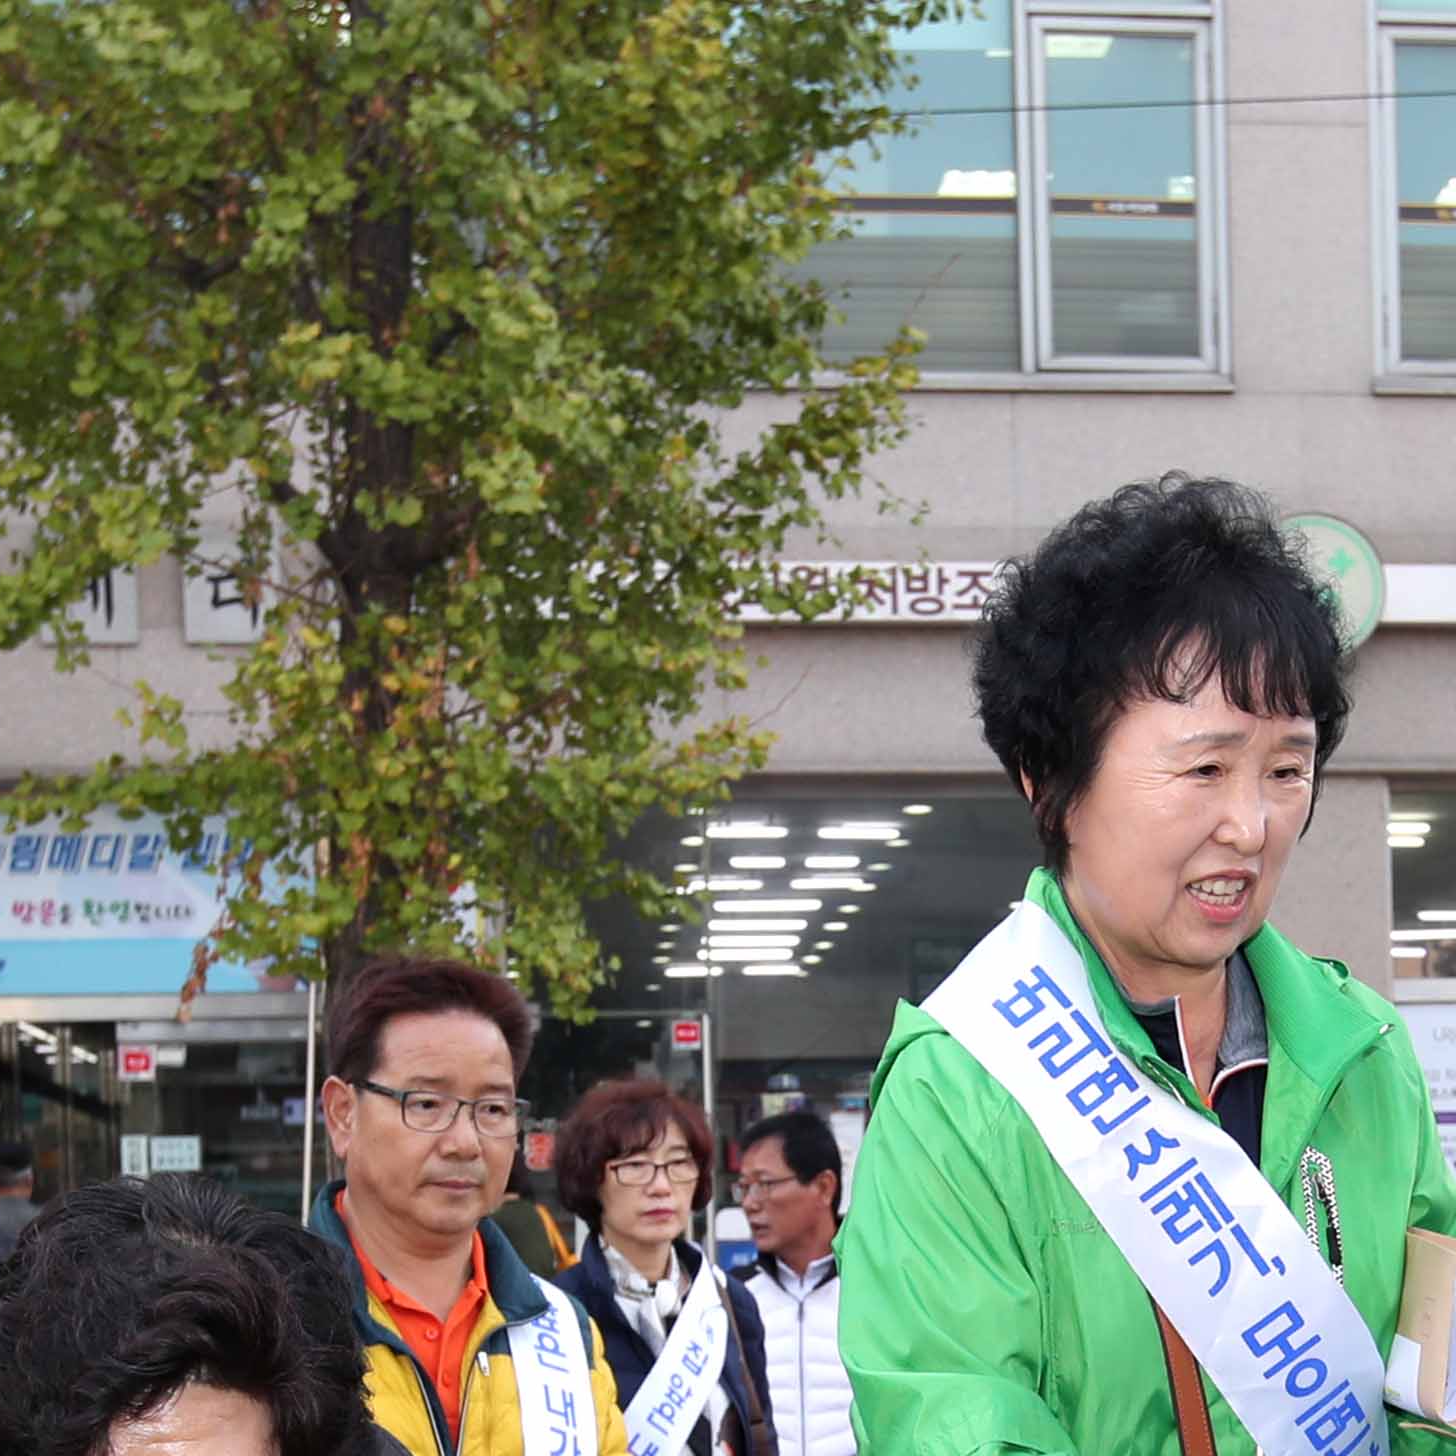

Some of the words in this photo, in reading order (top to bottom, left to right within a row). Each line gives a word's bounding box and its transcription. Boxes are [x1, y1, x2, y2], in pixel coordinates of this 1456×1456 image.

[11, 899, 72, 926] 방문을
[81, 899, 196, 925] 환영합니다
[992, 965, 1151, 1136] 버리면
